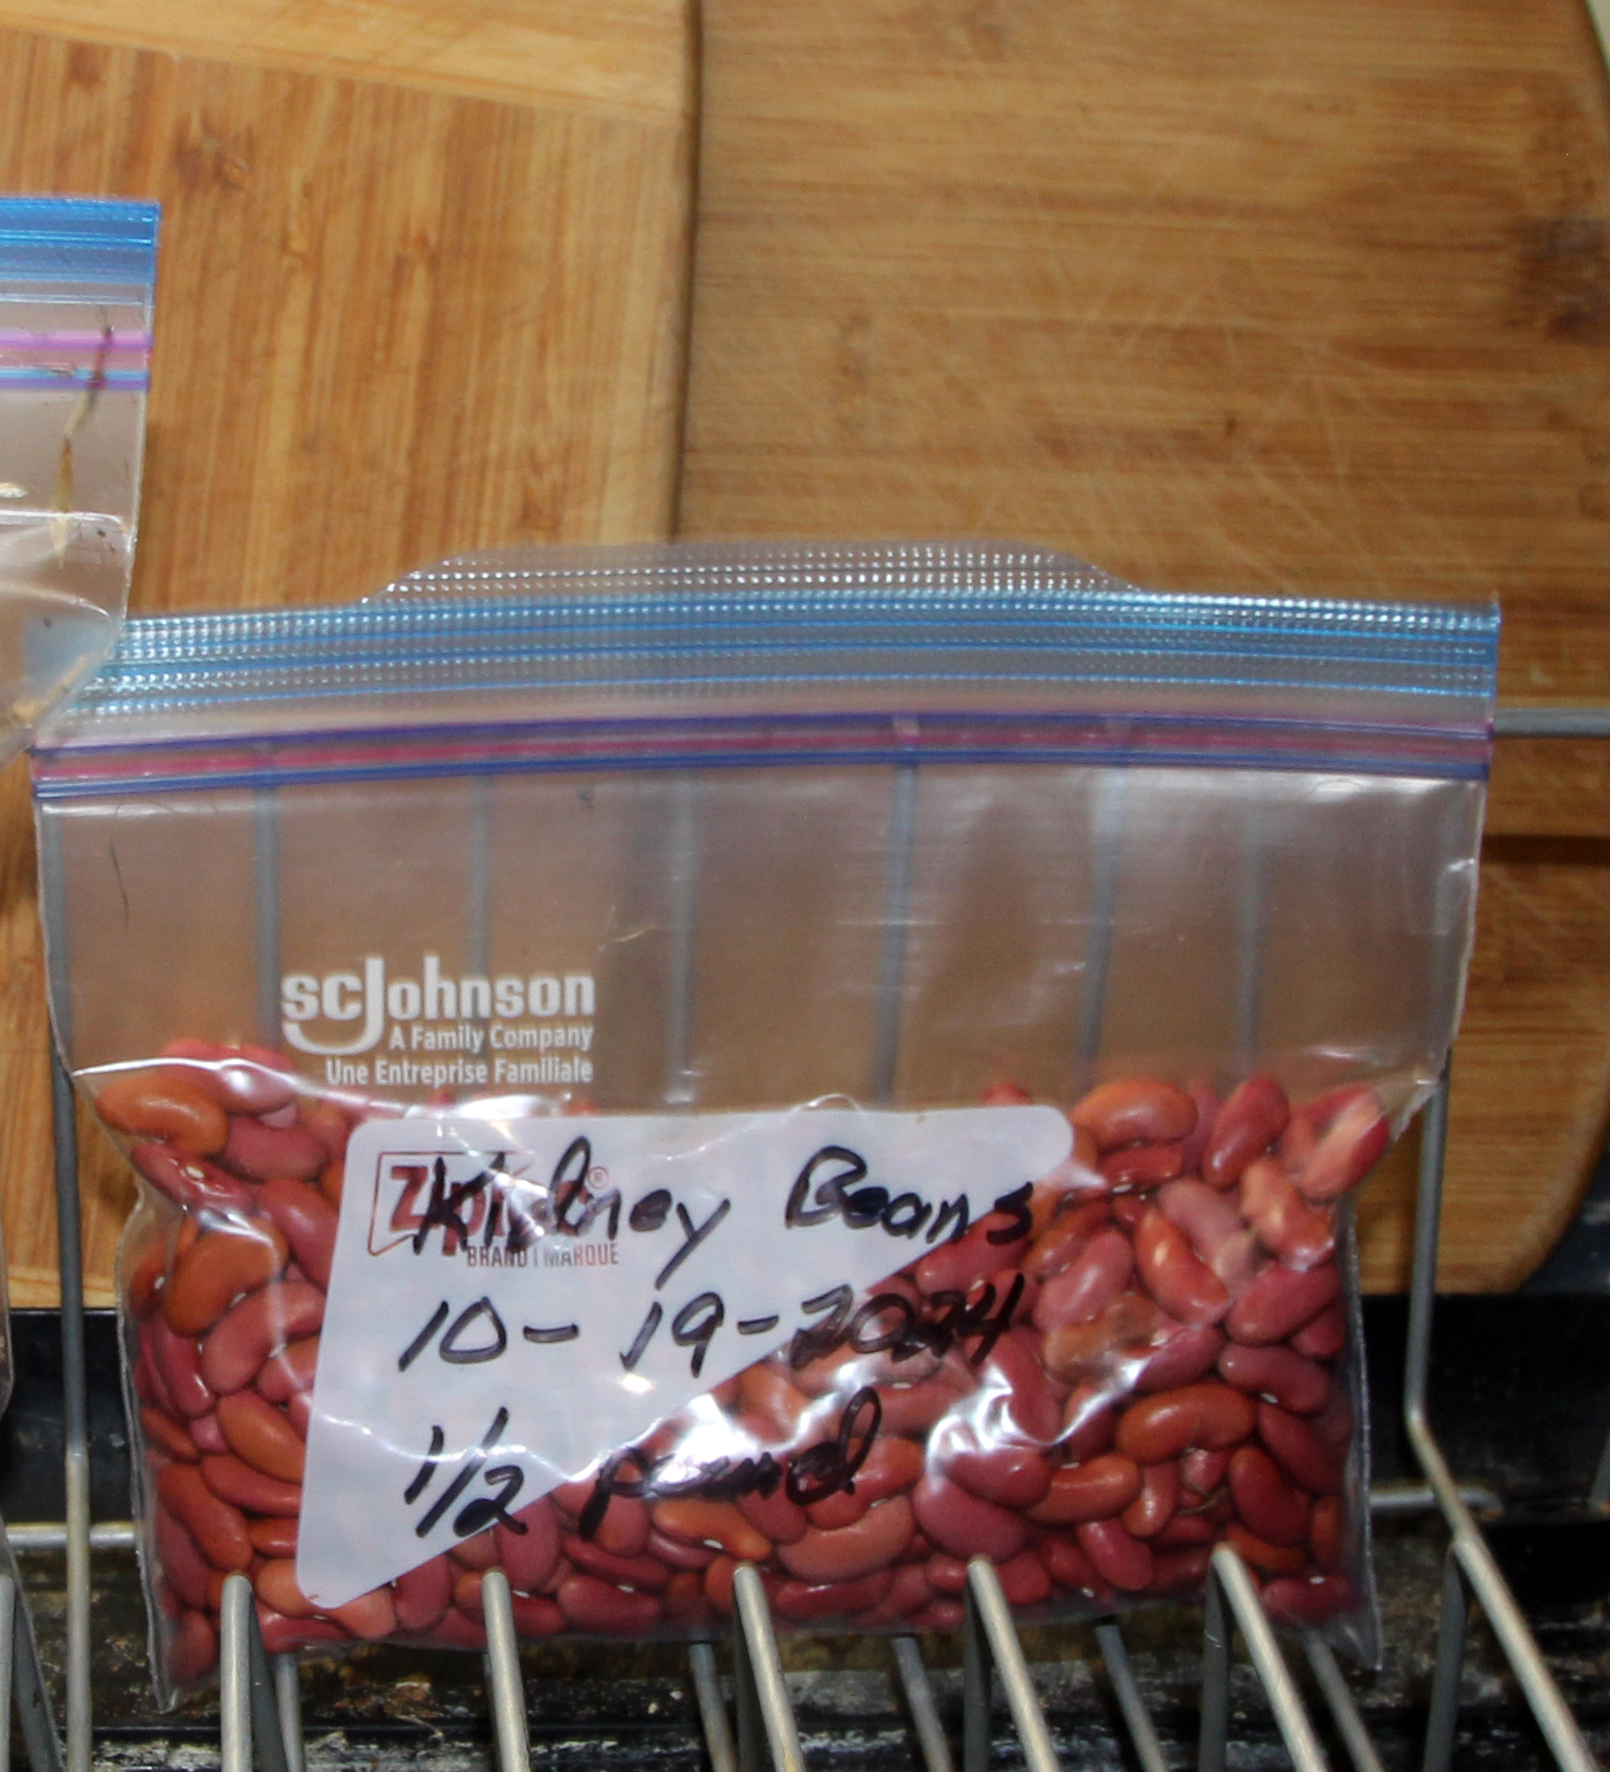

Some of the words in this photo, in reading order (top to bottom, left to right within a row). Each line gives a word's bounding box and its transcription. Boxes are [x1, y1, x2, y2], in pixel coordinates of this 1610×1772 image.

[391, 1026, 406, 1050] A
[410, 1026, 484, 1053] Family
[489, 1025, 595, 1052] Company
[325, 1060, 370, 1085] Une
[374, 1060, 487, 1089] Entreprise
[785, 1143, 1034, 1249] Beans
[466, 1243, 528, 1268] BRAND
[403, 1406, 529, 1539] 1/2
